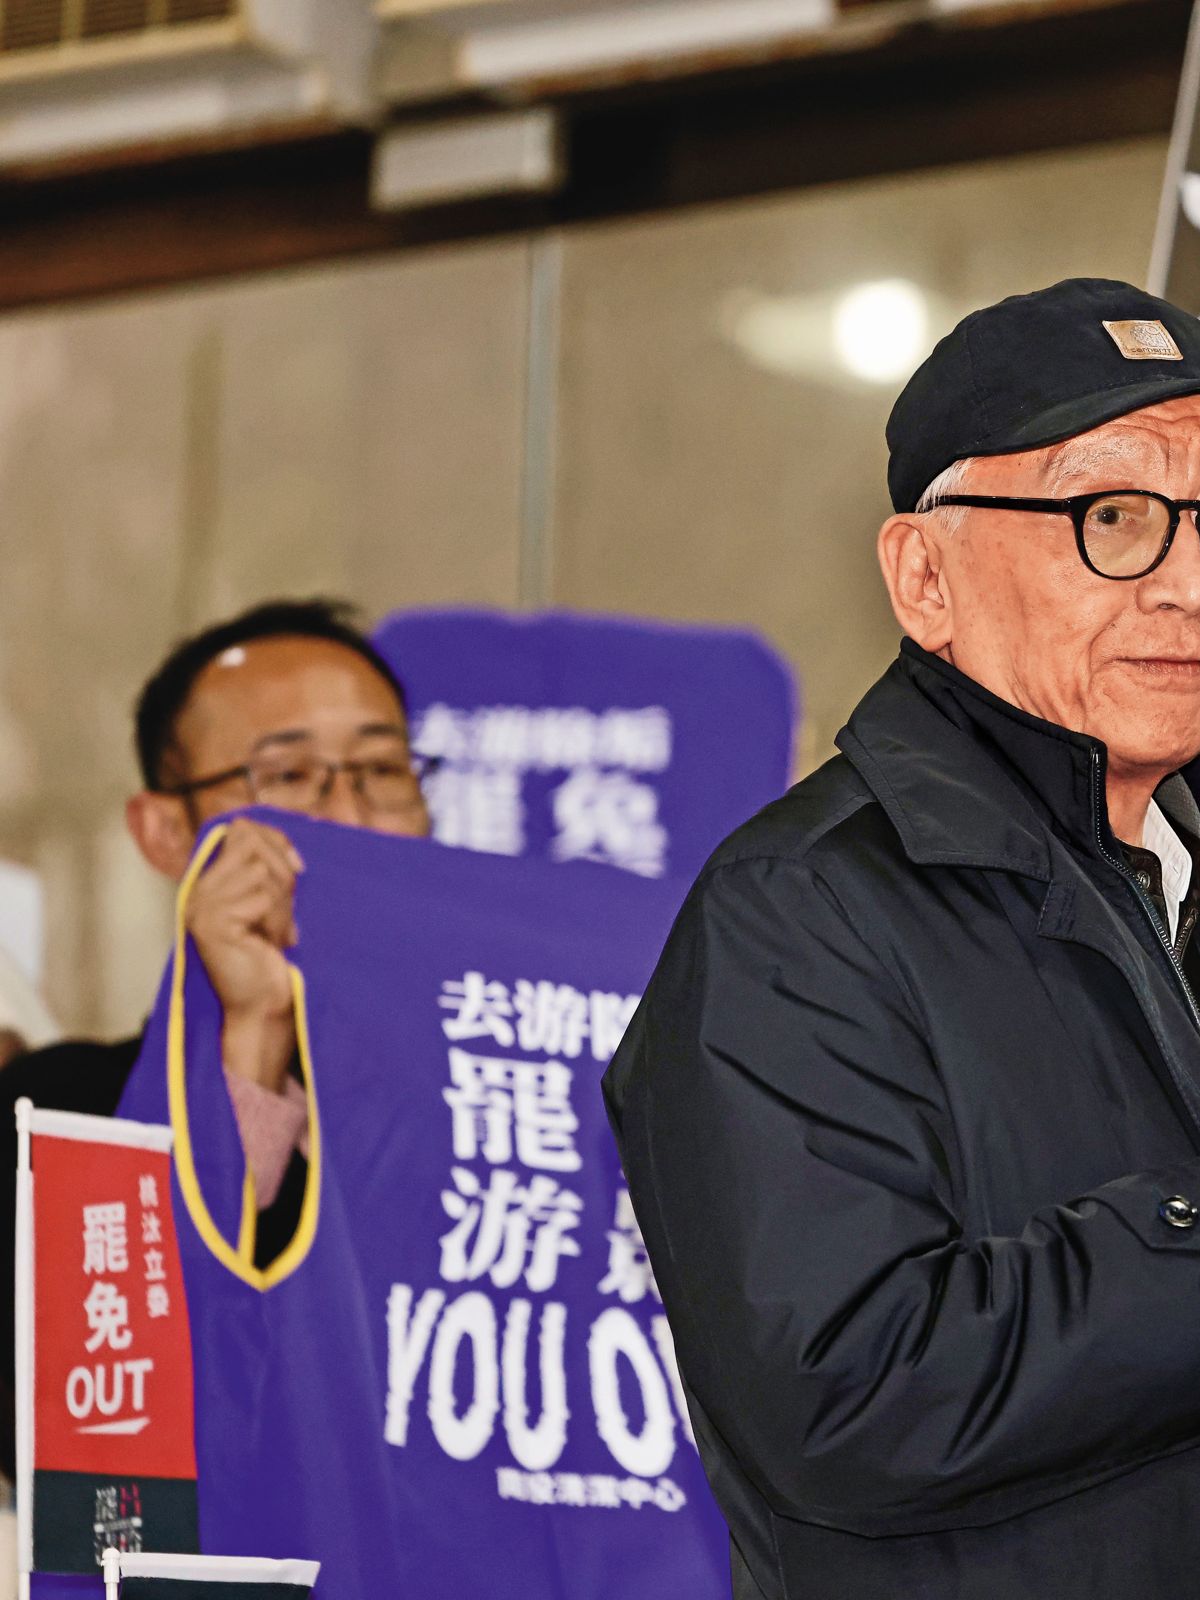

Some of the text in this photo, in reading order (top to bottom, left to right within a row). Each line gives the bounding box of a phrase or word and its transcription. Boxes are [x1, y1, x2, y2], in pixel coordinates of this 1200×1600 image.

[82, 1202, 134, 1353] 罷免
[66, 1359, 153, 1419] OUT
[385, 1283, 568, 1471] YOU
